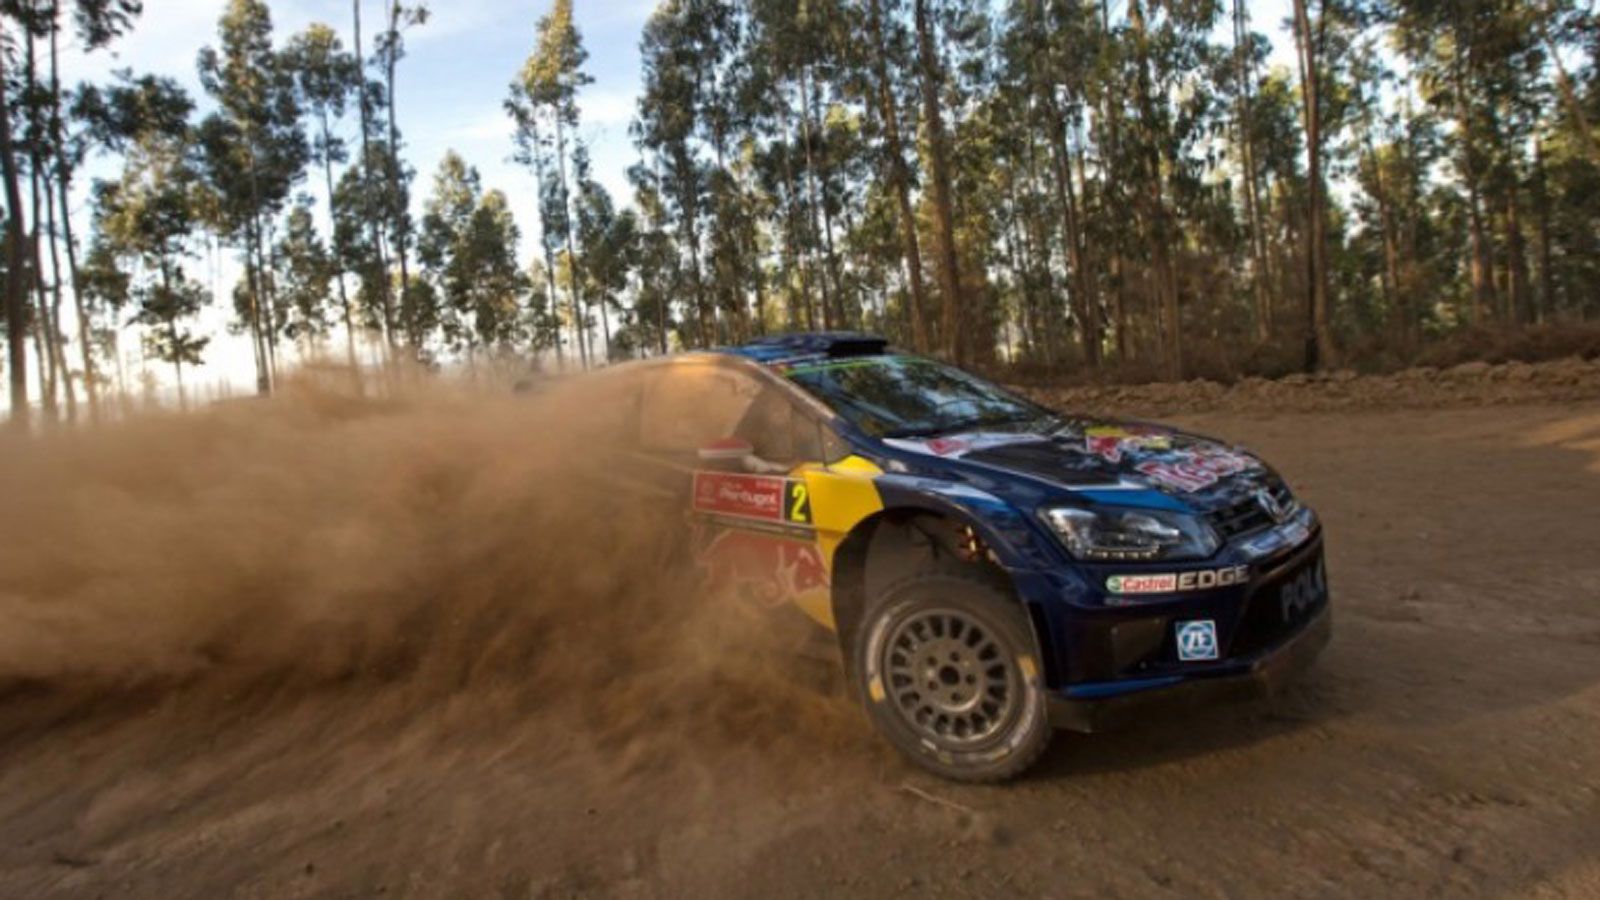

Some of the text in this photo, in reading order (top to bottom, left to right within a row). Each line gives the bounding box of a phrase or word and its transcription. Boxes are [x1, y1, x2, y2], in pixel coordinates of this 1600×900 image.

[792, 484, 806, 521] 2
[1123, 565, 1248, 591] Castrol EDGE
[1186, 631, 1210, 650] ZF
